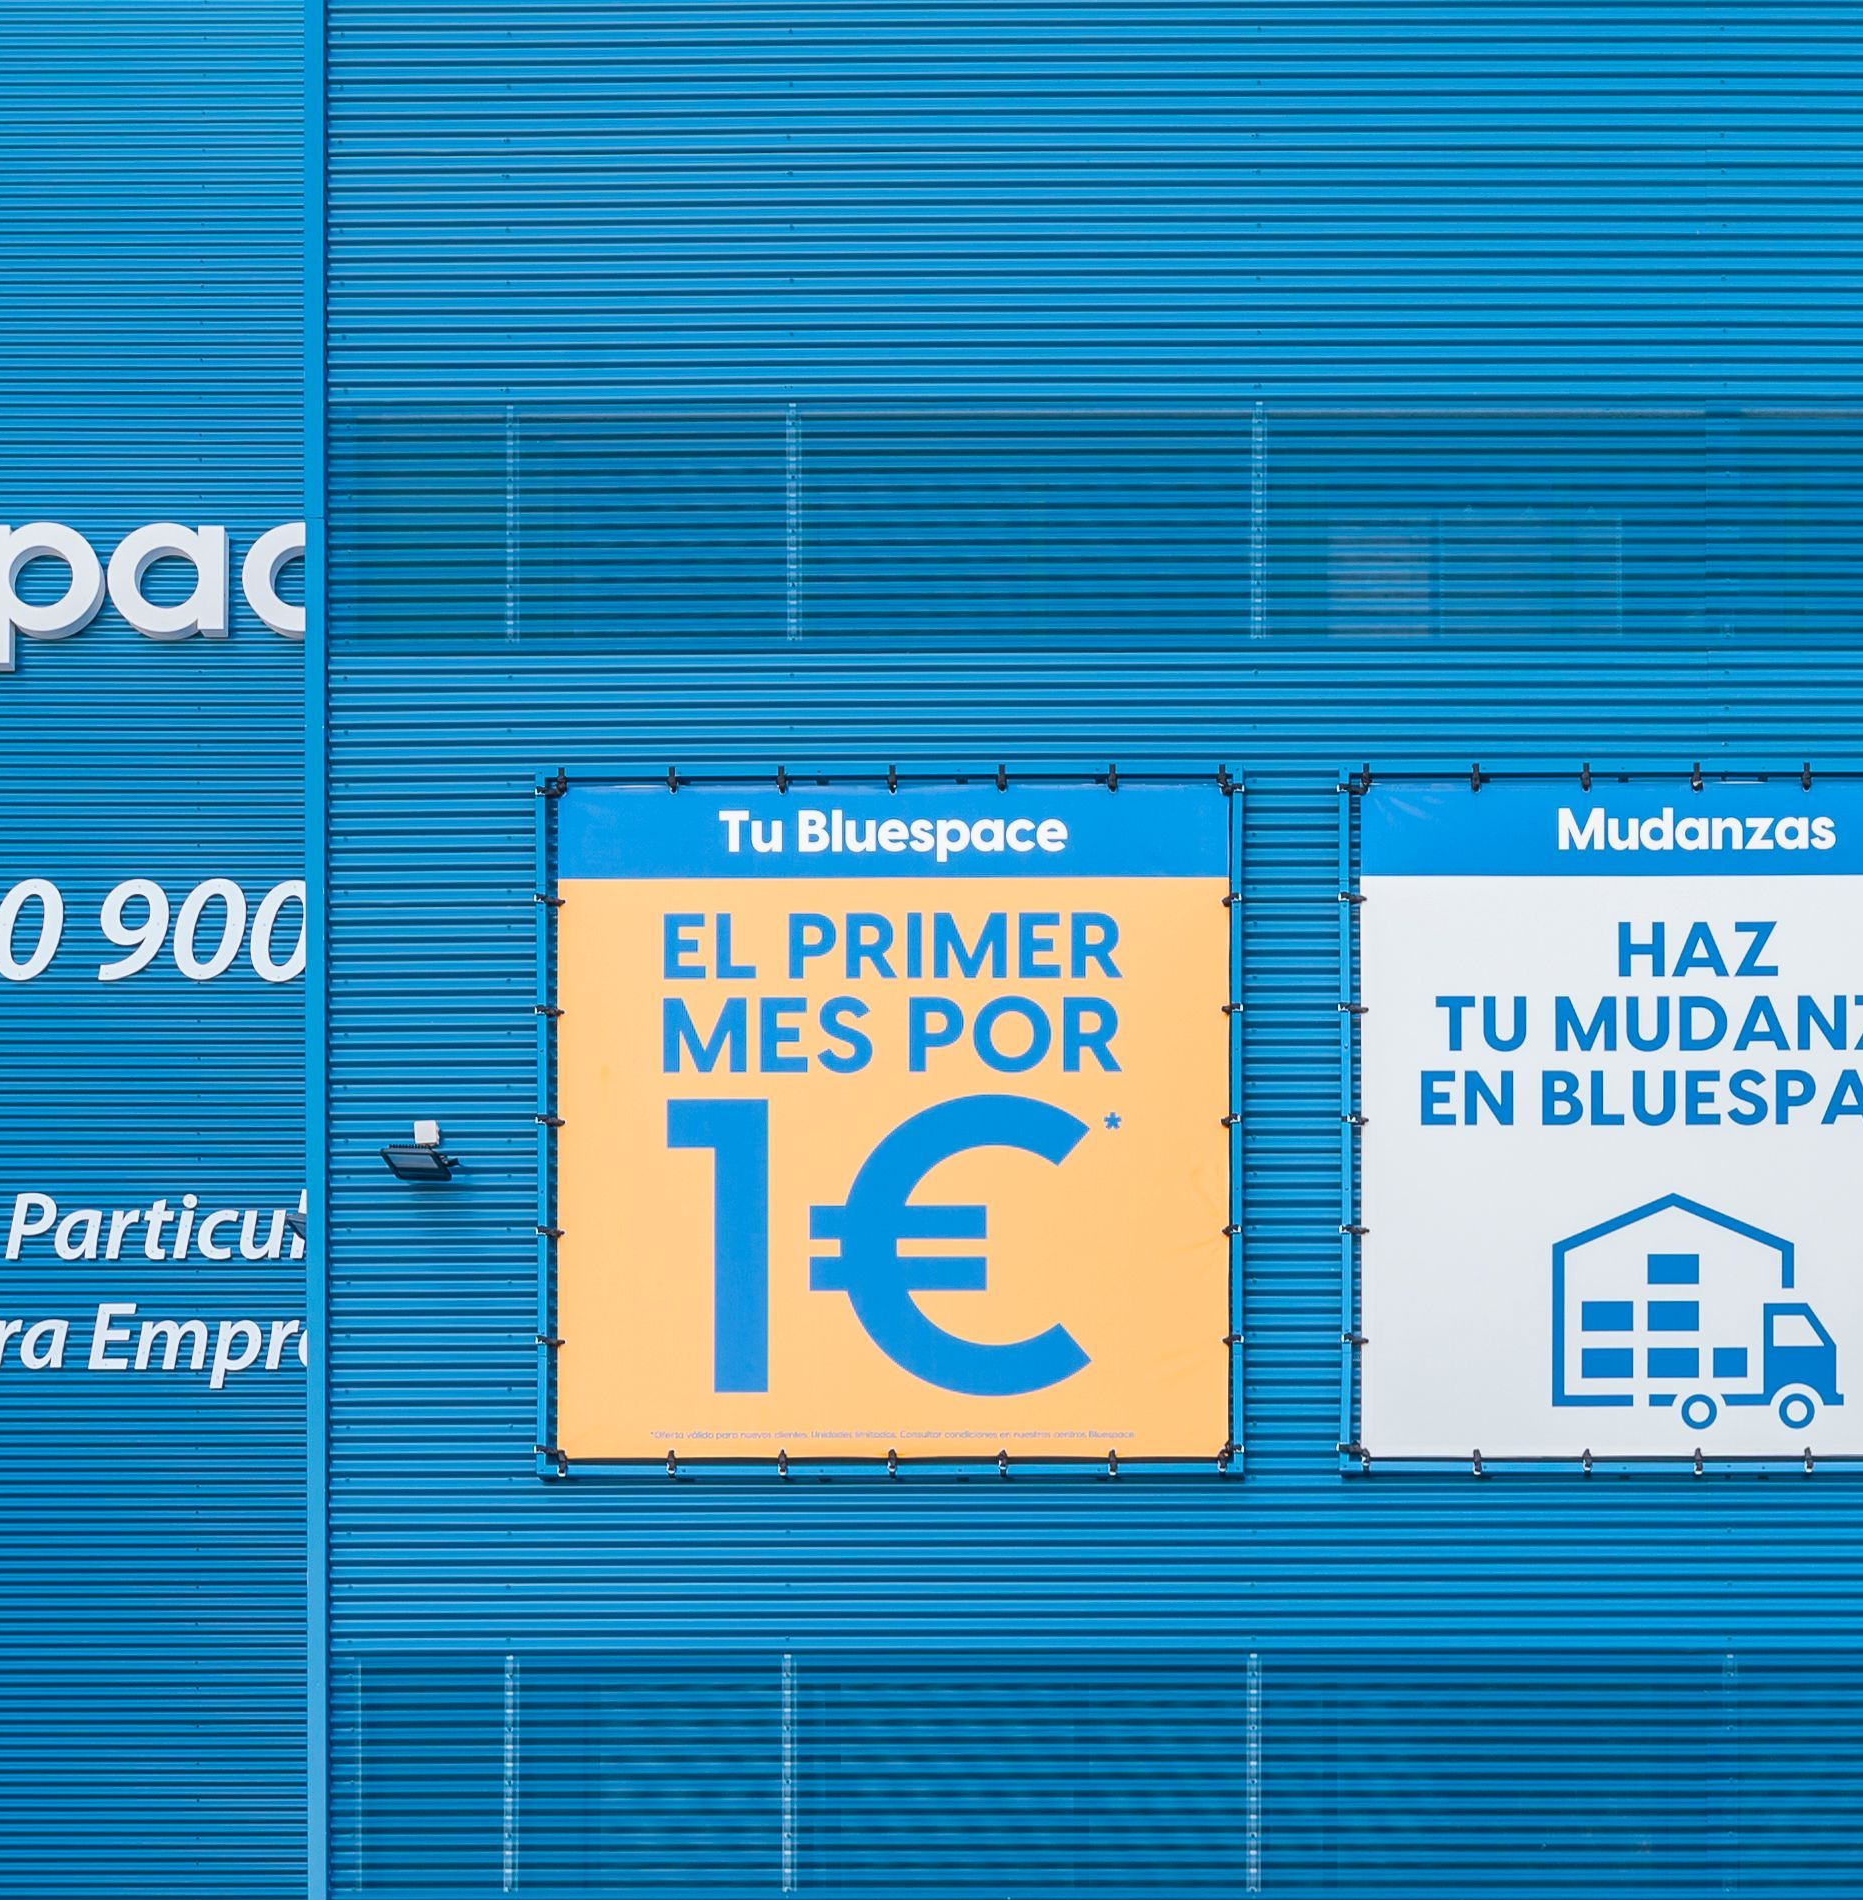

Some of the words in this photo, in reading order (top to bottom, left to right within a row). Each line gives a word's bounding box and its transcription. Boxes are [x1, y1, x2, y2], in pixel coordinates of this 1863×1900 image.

[719, 810, 782, 853] Tu
[798, 809, 1068, 862] Bluespace
[1558, 807, 1836, 851] Mudanzas
[98, 878, 307, 982] 900
[663, 912, 756, 979] EL
[788, 911, 1122, 979] PRIMER
[1617, 921, 1779, 977] HAZ
[662, 996, 873, 1073] MES
[908, 995, 1122, 1073] POR
[1435, 995, 1527, 1052] TU
[1420, 1070, 1514, 1126] EN
[88, 1303, 307, 1389] Empr
